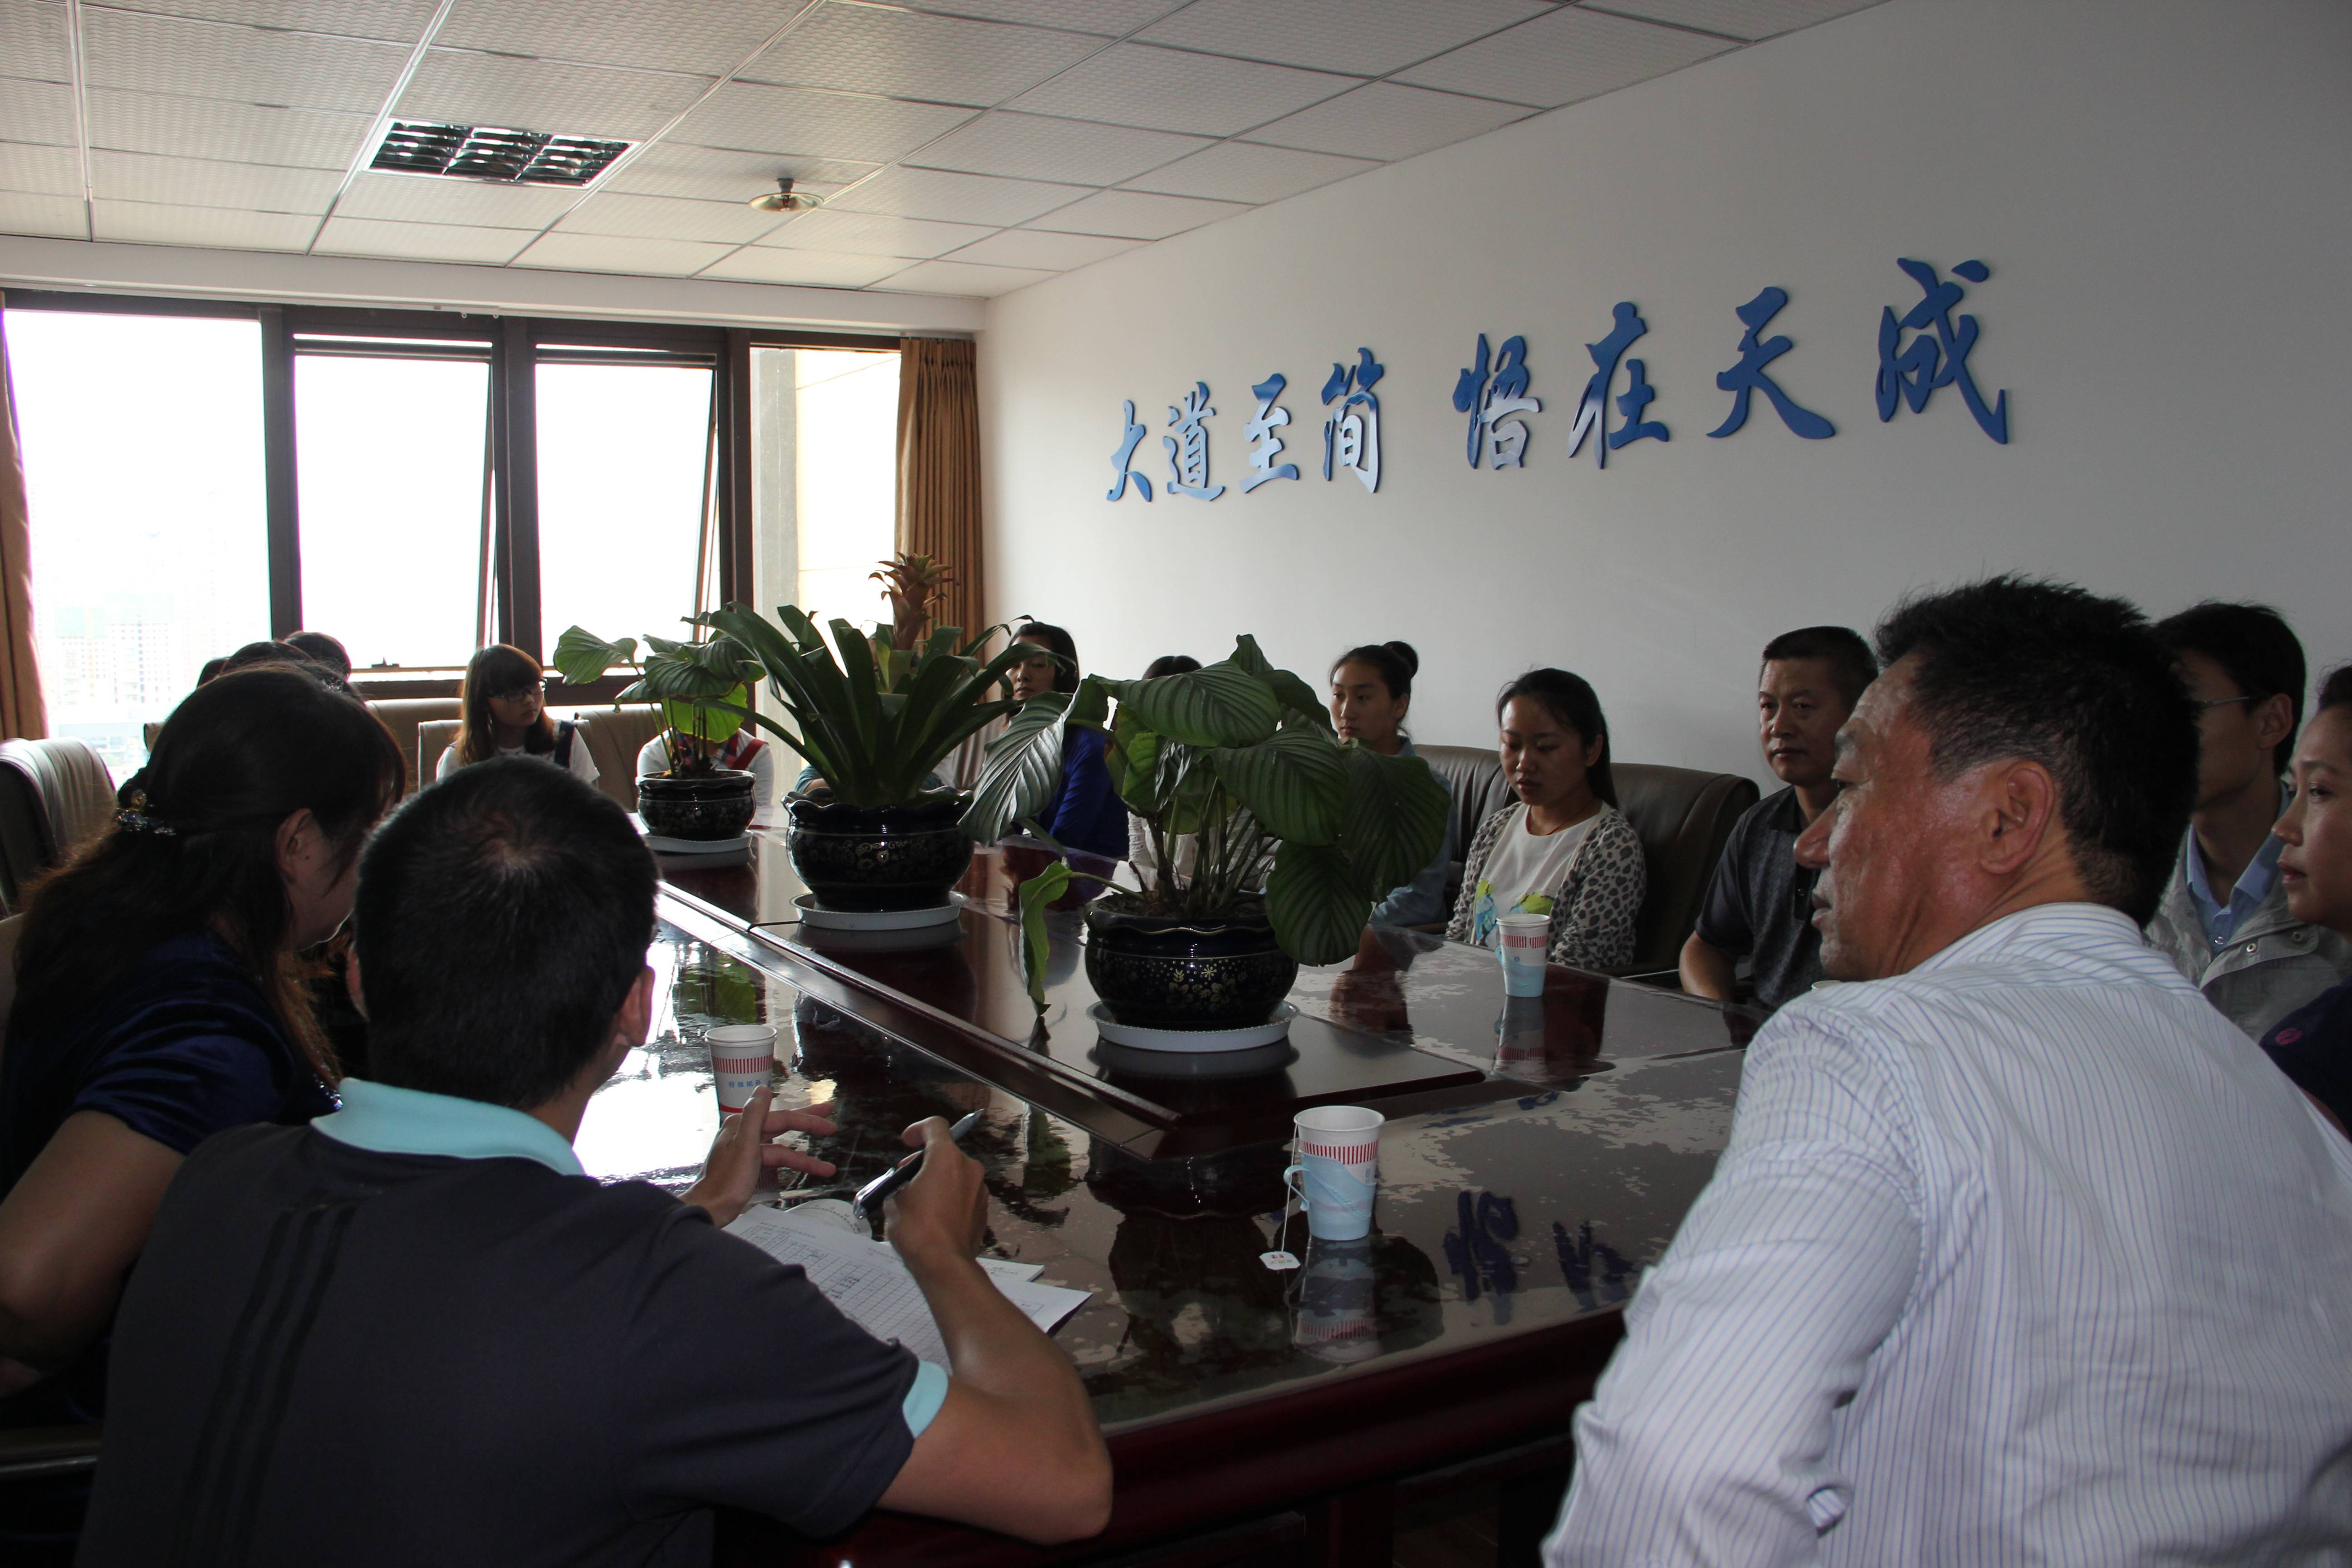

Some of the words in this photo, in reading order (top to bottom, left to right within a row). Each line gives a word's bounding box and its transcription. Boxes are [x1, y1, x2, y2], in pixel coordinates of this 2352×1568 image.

[1106, 346, 1384, 502] 大道至简
[1452, 257, 2009, 470] 悟在天成
